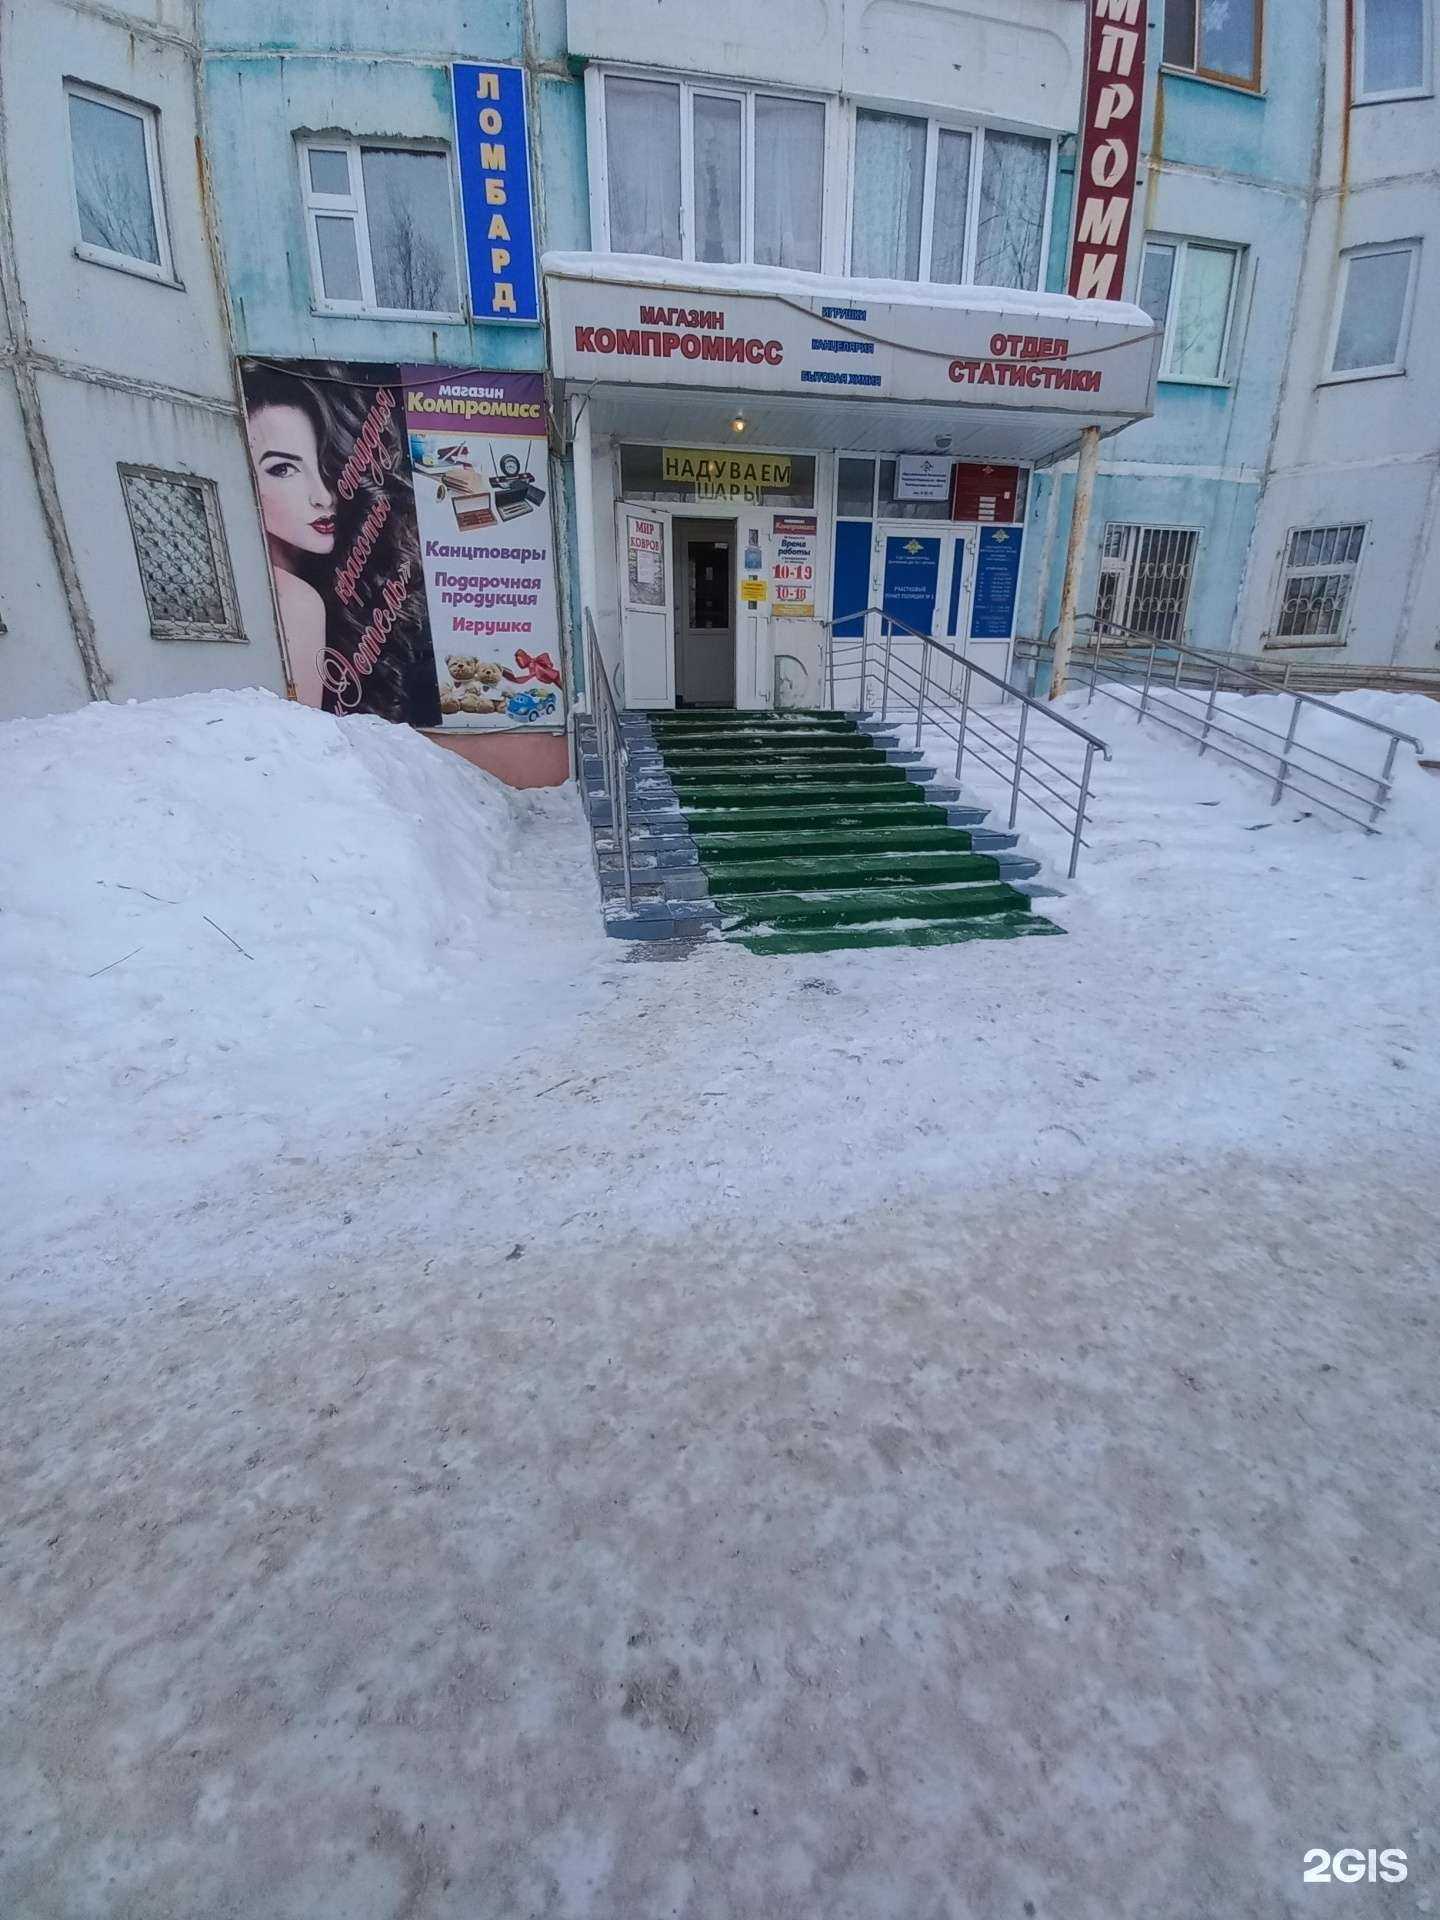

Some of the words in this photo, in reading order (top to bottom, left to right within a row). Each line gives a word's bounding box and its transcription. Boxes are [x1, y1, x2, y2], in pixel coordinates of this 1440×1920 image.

[476, 72, 517, 313] ЛОМБАРД
[640, 305, 724, 330] МАГАЗИН
[821, 306, 867, 321] ИГРУШКИ
[575, 326, 783, 366] КОМПРОМИСС
[990, 333, 1069, 361] ОТДЕЛ
[800, 370, 848, 385] БЫТОВАЯ
[847, 373, 882, 387] ХИМИЯ
[948, 360, 1102, 392] СТАТИСТИКИ
[438, 385, 504, 399] магазин
[407, 391, 541, 419] Компромисс
[337, 386, 396, 500] студия
[665, 457, 792, 483] НАДУВАЕМ
[696, 482, 760, 505] ШАРЫ
[635, 520, 655, 535] МИР
[335, 494, 391, 607] красоты
[425, 540, 547, 564] Канцтовары
[630, 536, 660, 551] КОВРОВ
[434, 571, 542, 592] Подарочная
[772, 564, 812, 580] 10-19
[441, 592, 538, 608] продукция
[452, 617, 532, 635] Игрушка
